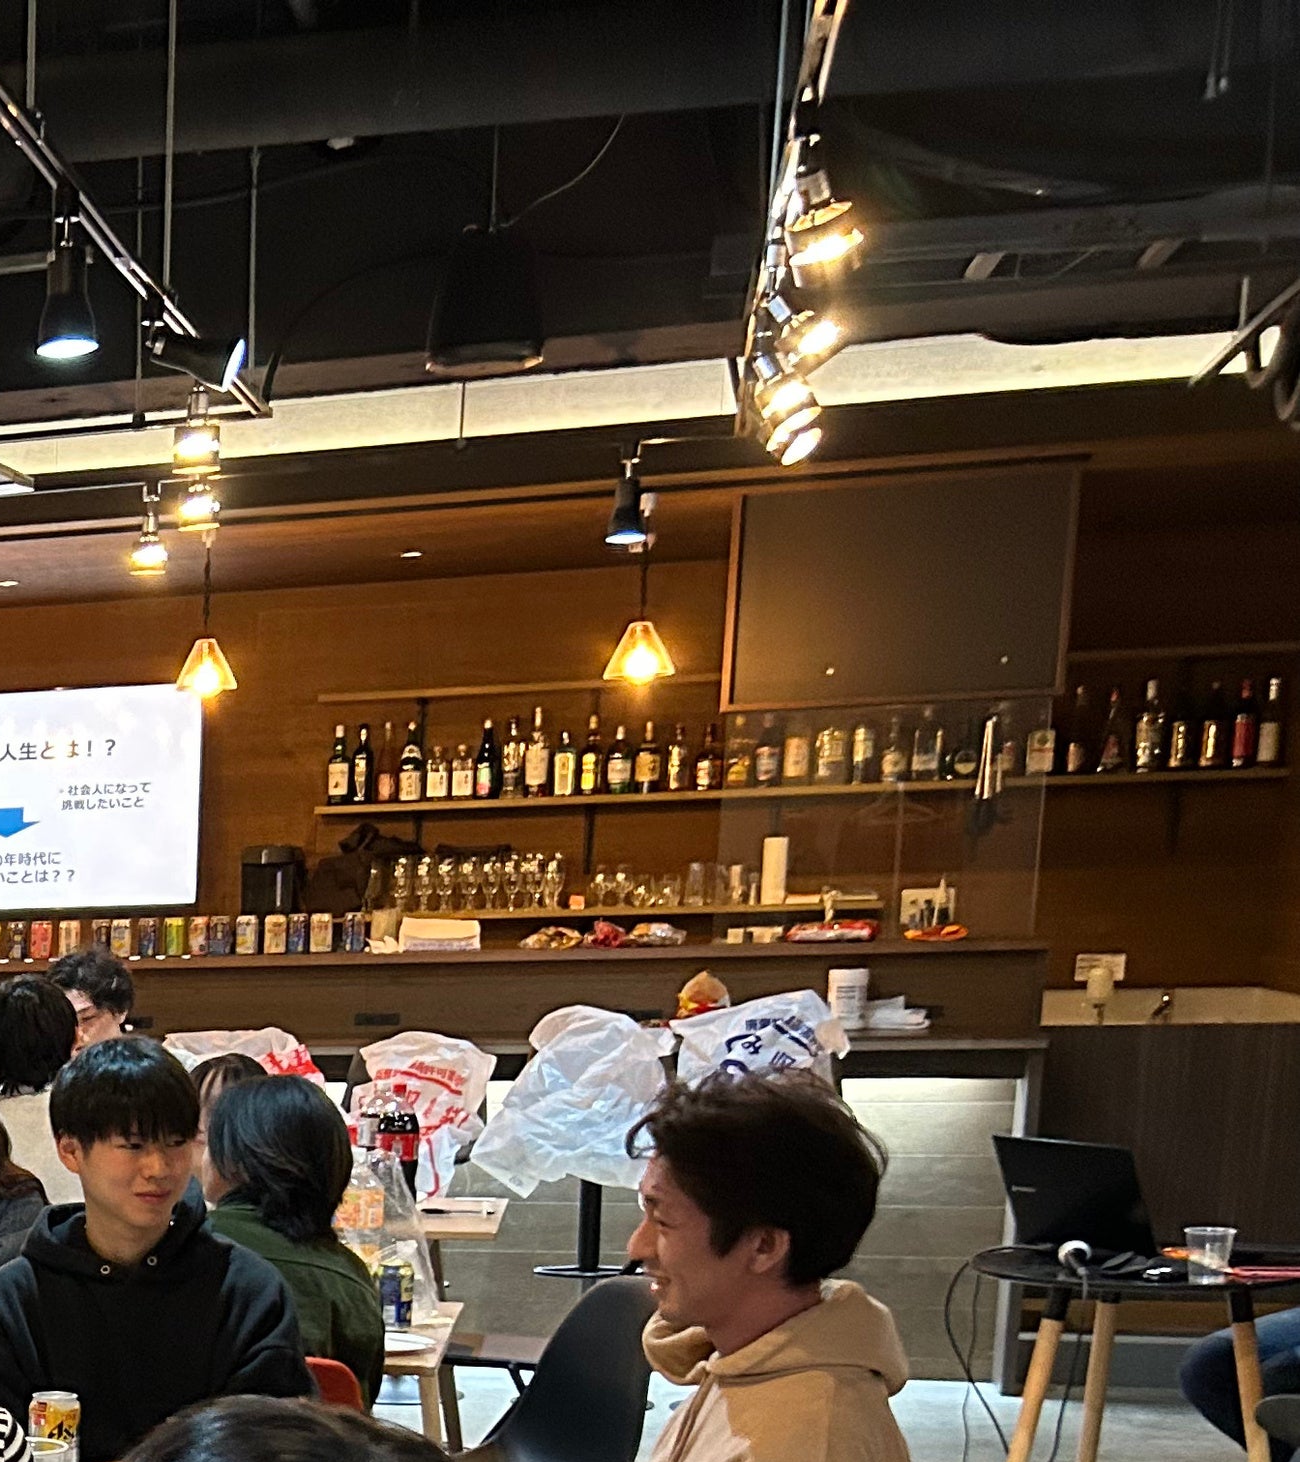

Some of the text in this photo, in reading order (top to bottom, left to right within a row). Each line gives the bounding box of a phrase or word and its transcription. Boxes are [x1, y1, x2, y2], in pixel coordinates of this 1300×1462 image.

[67, 782, 152, 796] 社会人になって
[61, 796, 145, 811] 挑戦したいこと
